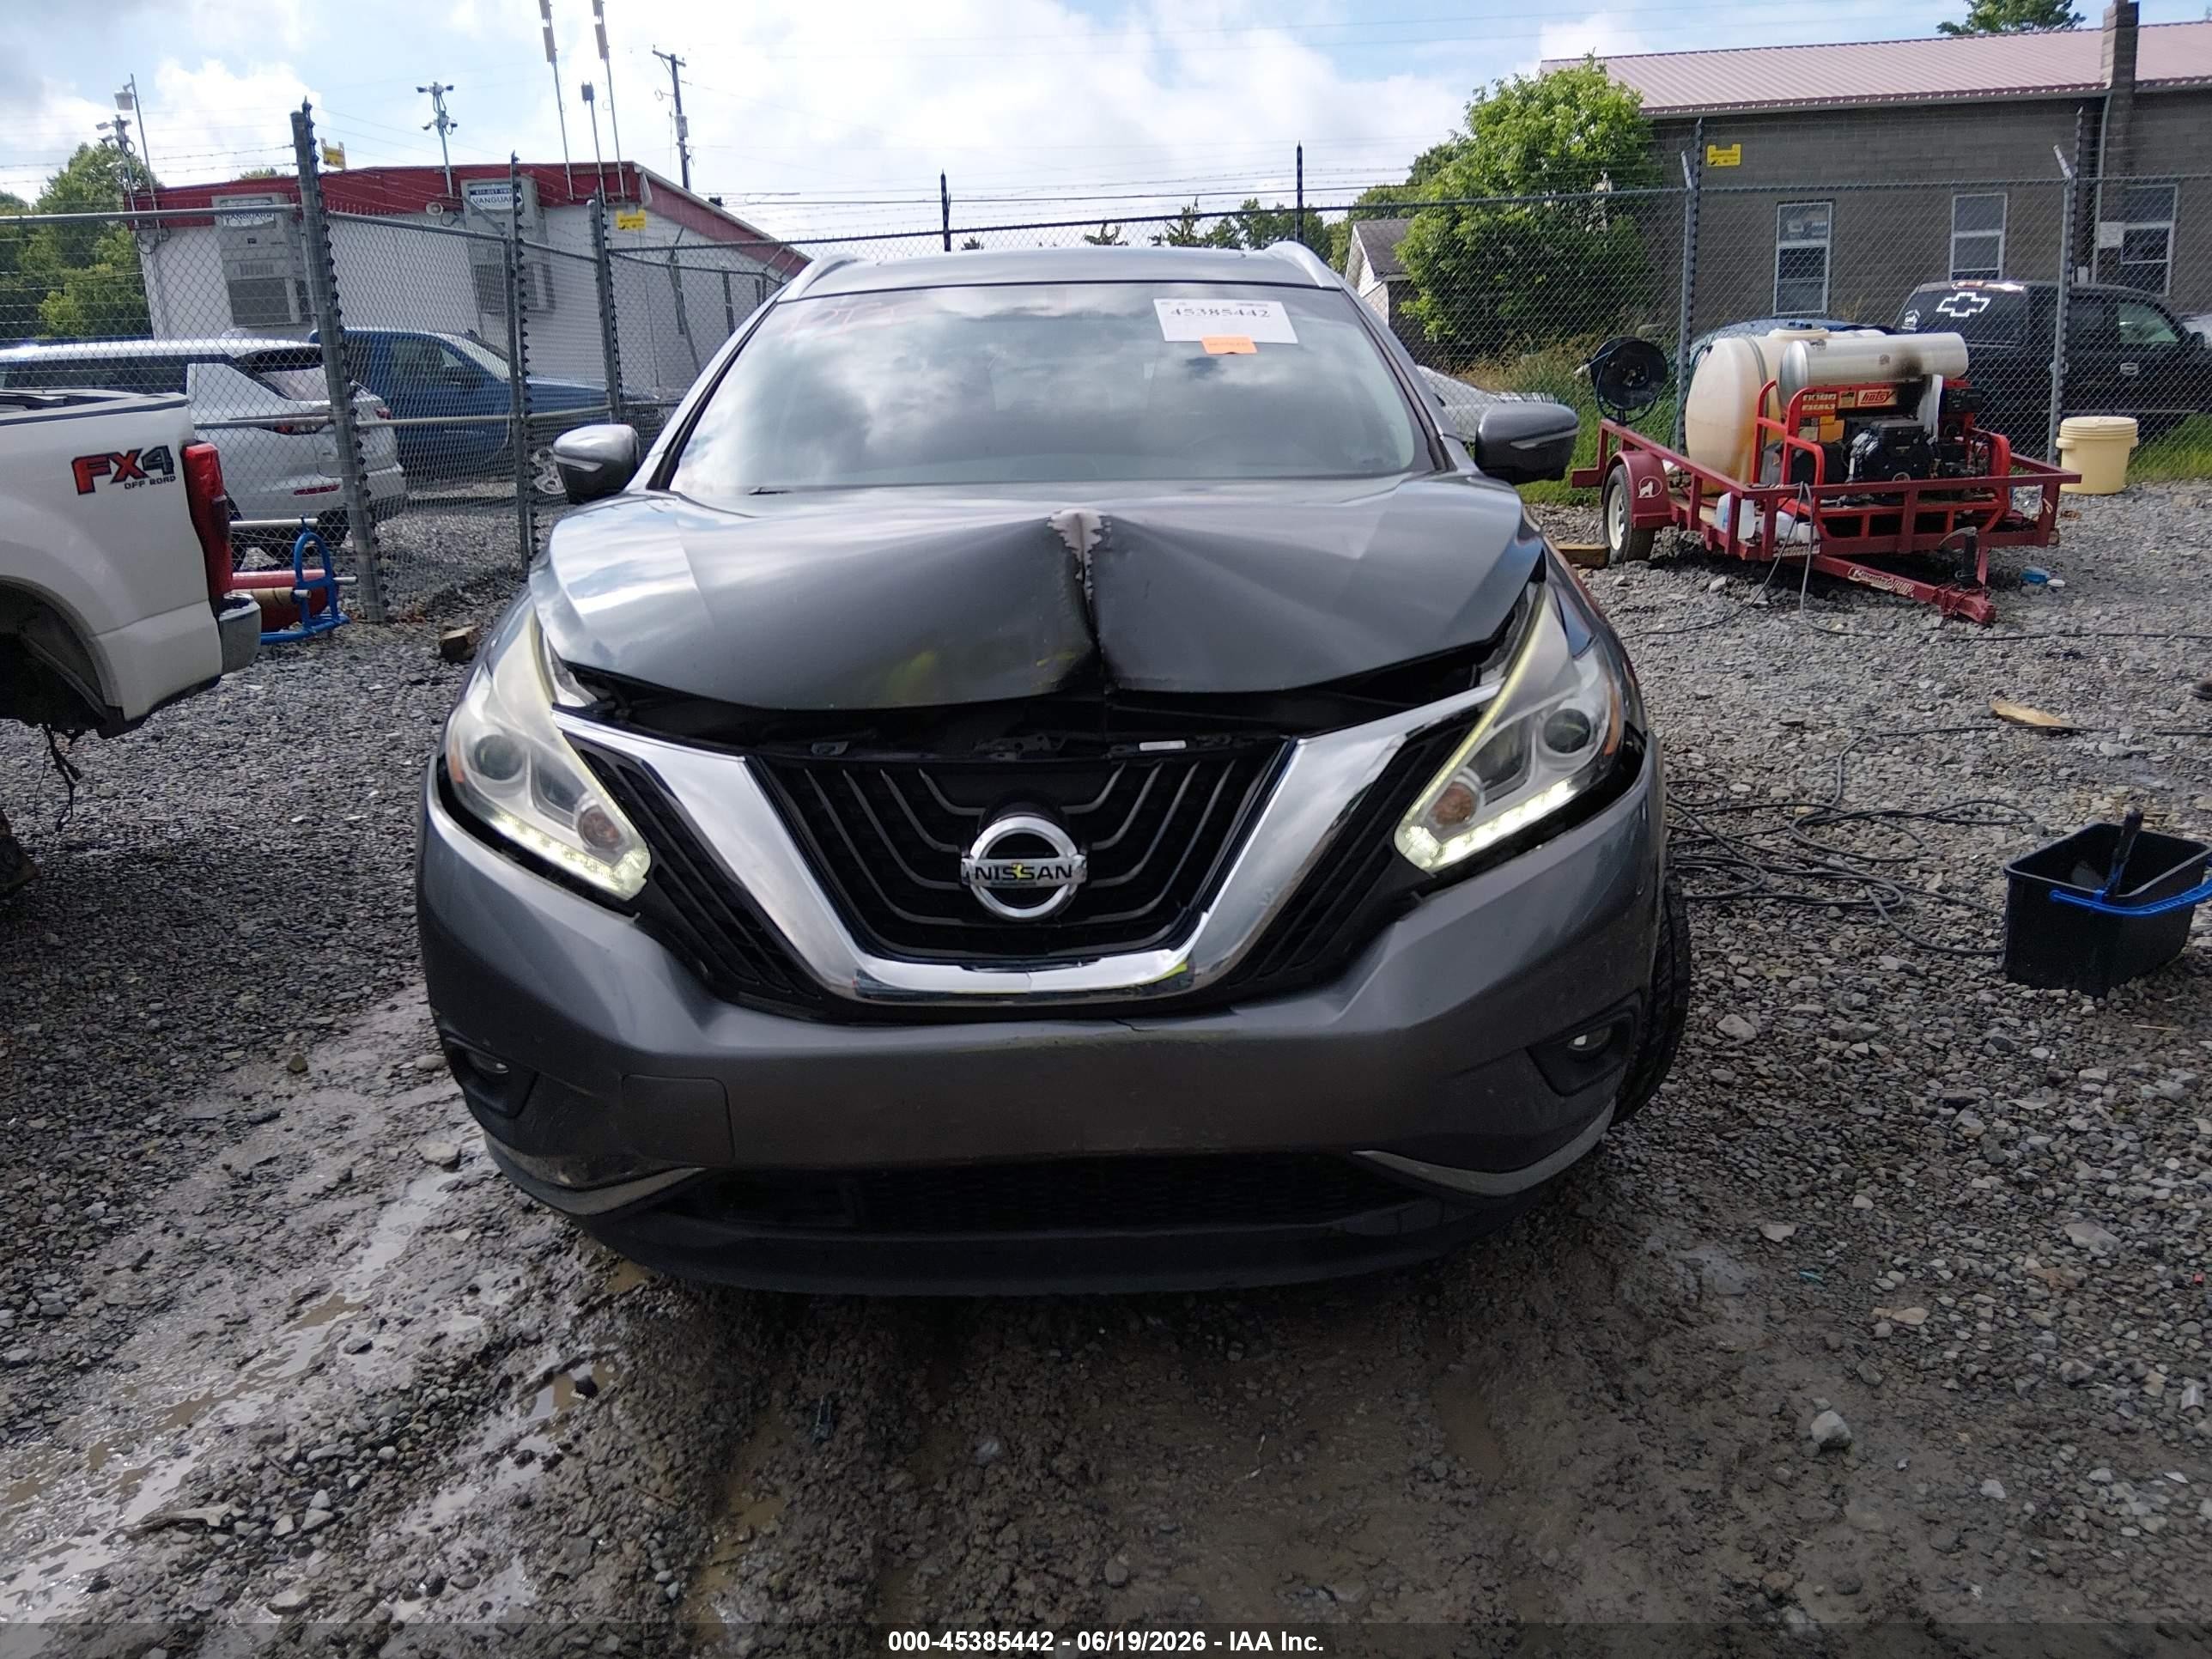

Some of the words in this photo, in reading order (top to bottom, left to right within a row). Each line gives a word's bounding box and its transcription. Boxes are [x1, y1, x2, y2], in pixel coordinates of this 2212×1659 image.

[1170, 307, 1271, 318] 45385442
[71, 445, 174, 495] FX4
[124, 479, 146, 489] OFF
[149, 475, 176, 486] ROAD
[975, 864, 1073, 880] NISSAN
